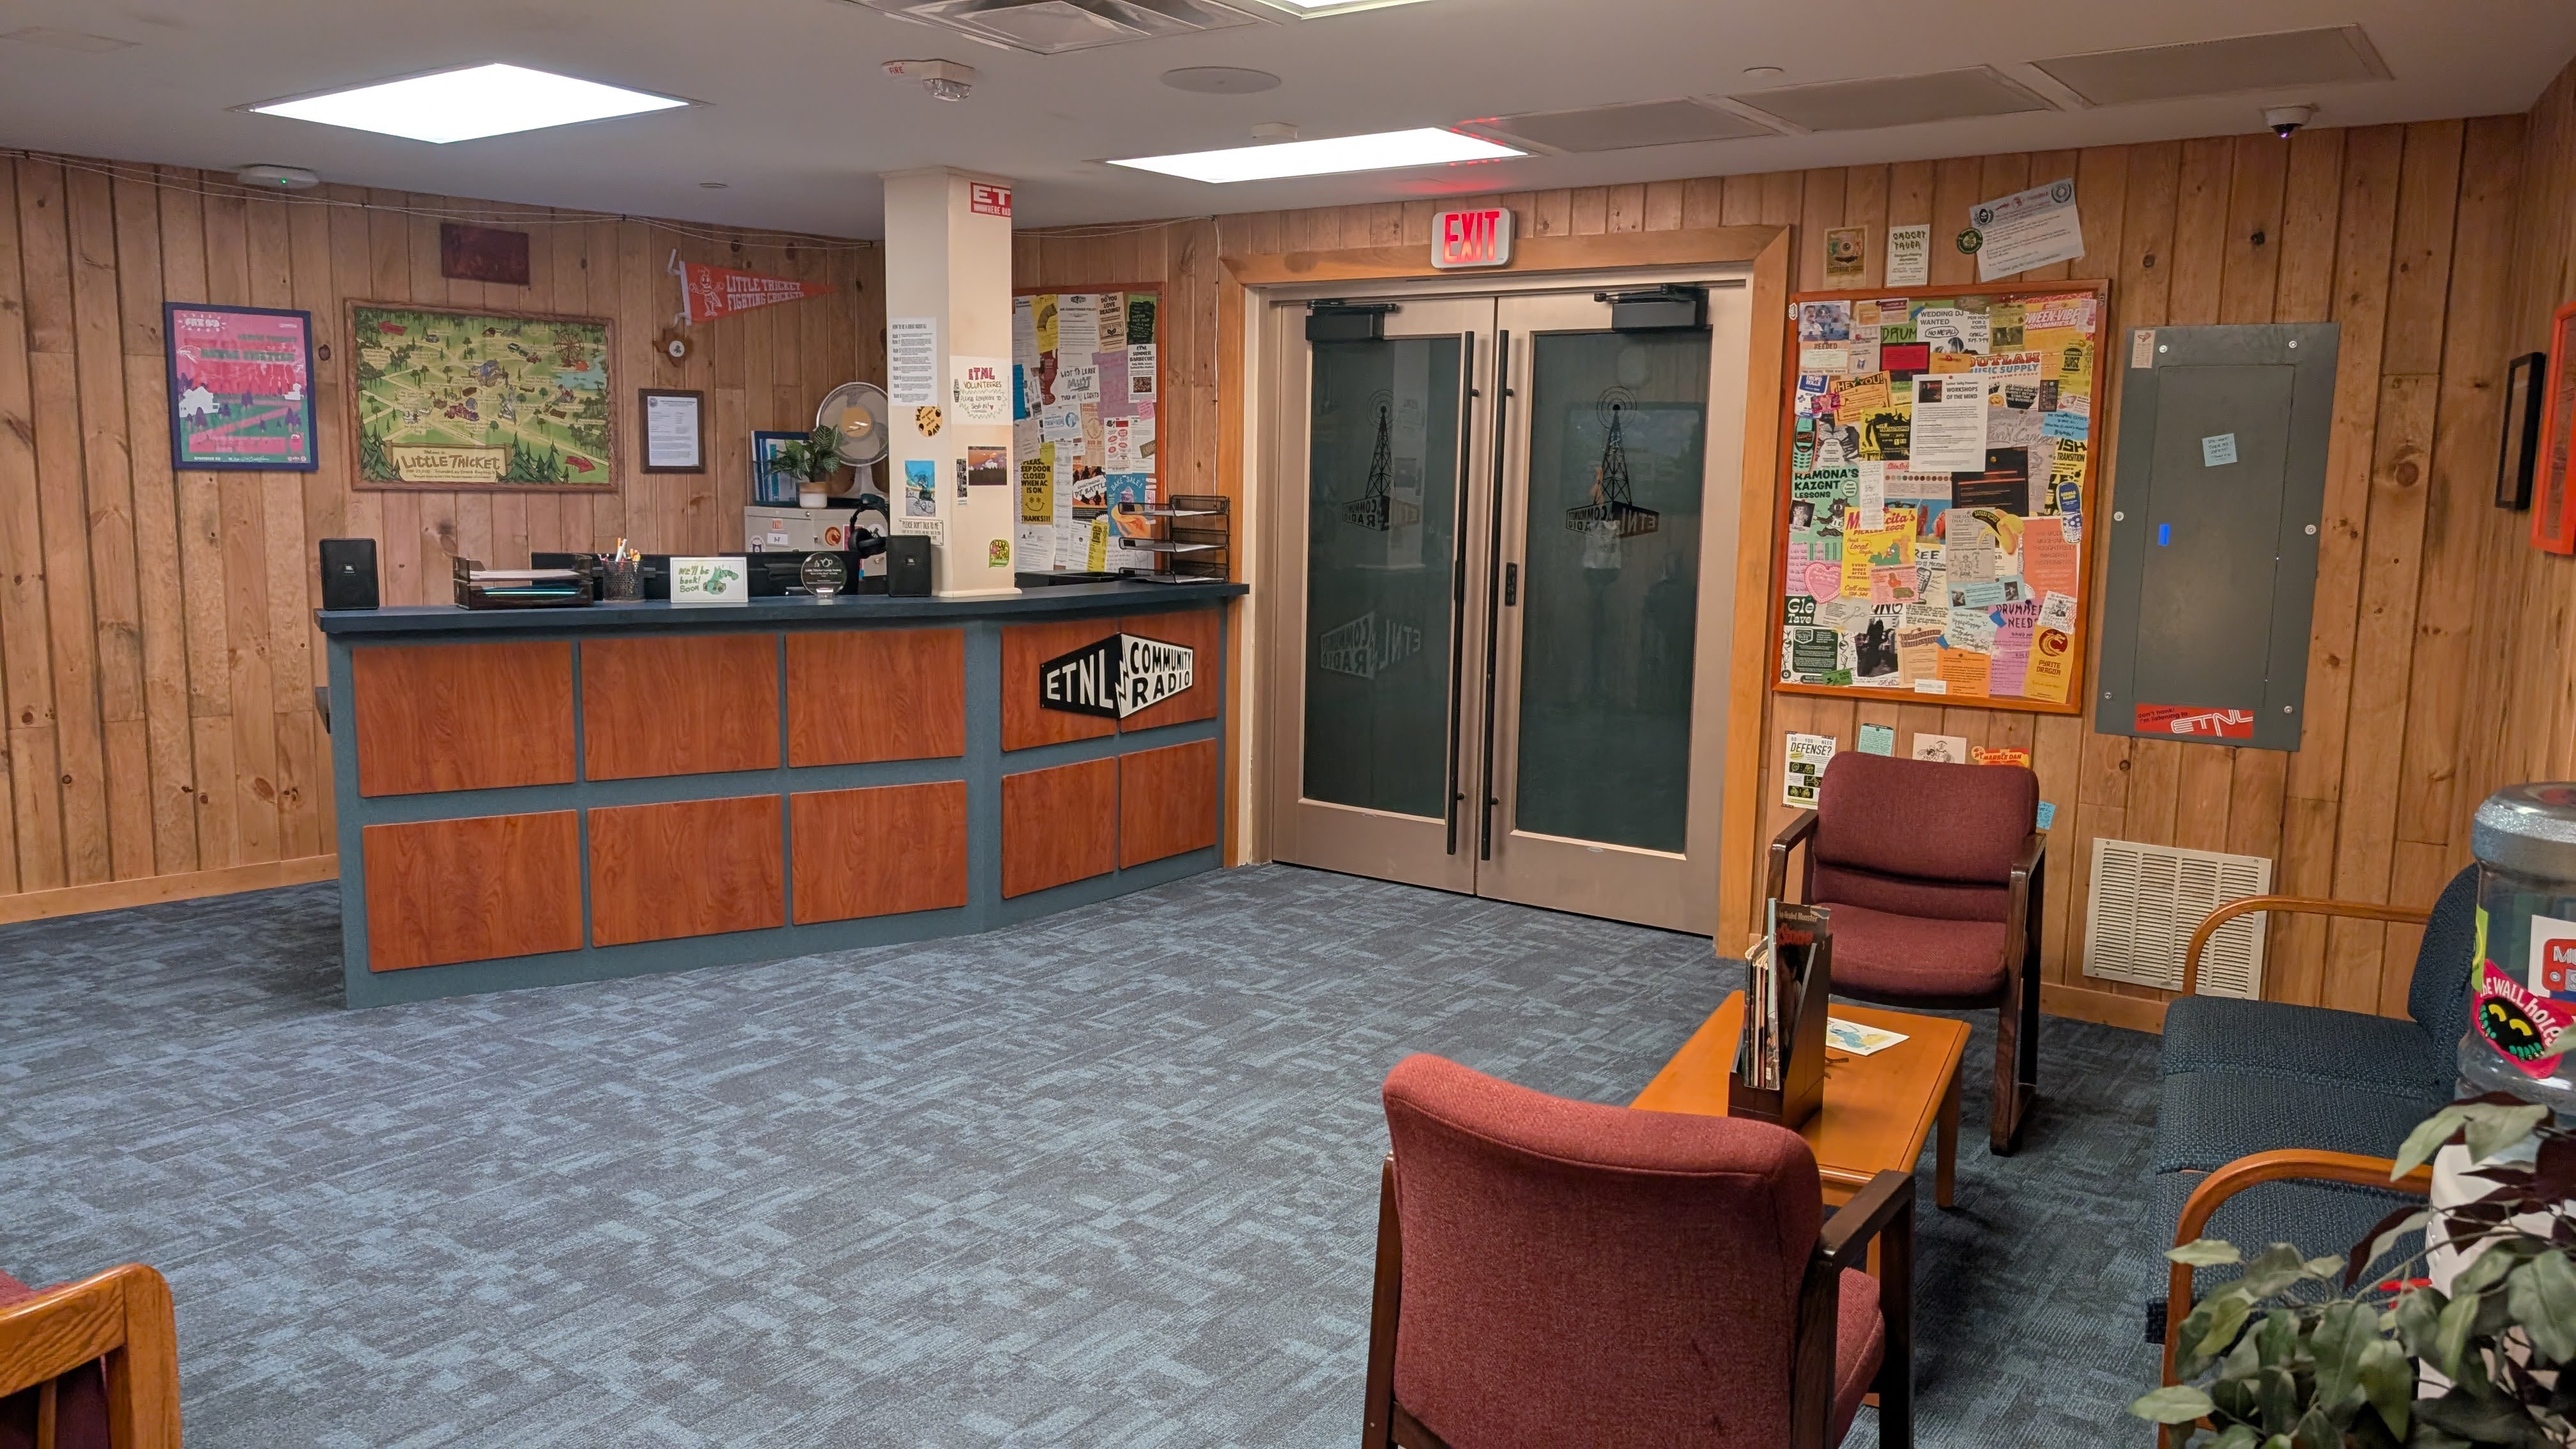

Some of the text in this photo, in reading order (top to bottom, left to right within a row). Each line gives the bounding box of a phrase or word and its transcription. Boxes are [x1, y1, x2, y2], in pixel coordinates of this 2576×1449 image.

[1443, 211, 1500, 263] EXIT
[726, 275, 801, 292] LITTLE THICKET
[728, 293, 766, 311] FIGHTING
[1100, 307, 1121, 315] READING?
[969, 367, 995, 380] ETNL
[2000, 364, 2039, 373] SUPPLY
[1068, 376, 1092, 390] MUST
[1837, 379, 1857, 391] HEY
[1860, 374, 1884, 385] YOU!
[928, 424, 940, 436] DAN
[2057, 452, 2085, 463] TRANSITION
[1794, 468, 1859, 480] RAMONA'S
[1075, 489, 1082, 498] DJ
[1084, 482, 1107, 494] BATTL
[1110, 477, 1124, 492] BAKE
[1126, 476, 1142, 489] SALE!
[1794, 480, 1840, 491] KAZGNT
[1788, 599, 1814, 614] Gle
[1788, 613, 1812, 624] Tave
[2008, 618, 2038, 628] NEED
[2036, 666, 2061, 675] DRAGON
[2039, 660, 2060, 668] PYRITE
[1047, 641, 1192, 709] ETNL COMMUNITY
[1131, 671, 1190, 709] RADIO
[2150, 712, 2180, 723] listening
[2171, 709, 2253, 737] ETNL
[1790, 742, 1832, 756] DEFENSE?
[1797, 913, 1818, 923] Monster
[2493, 976, 2524, 1008] WALL
